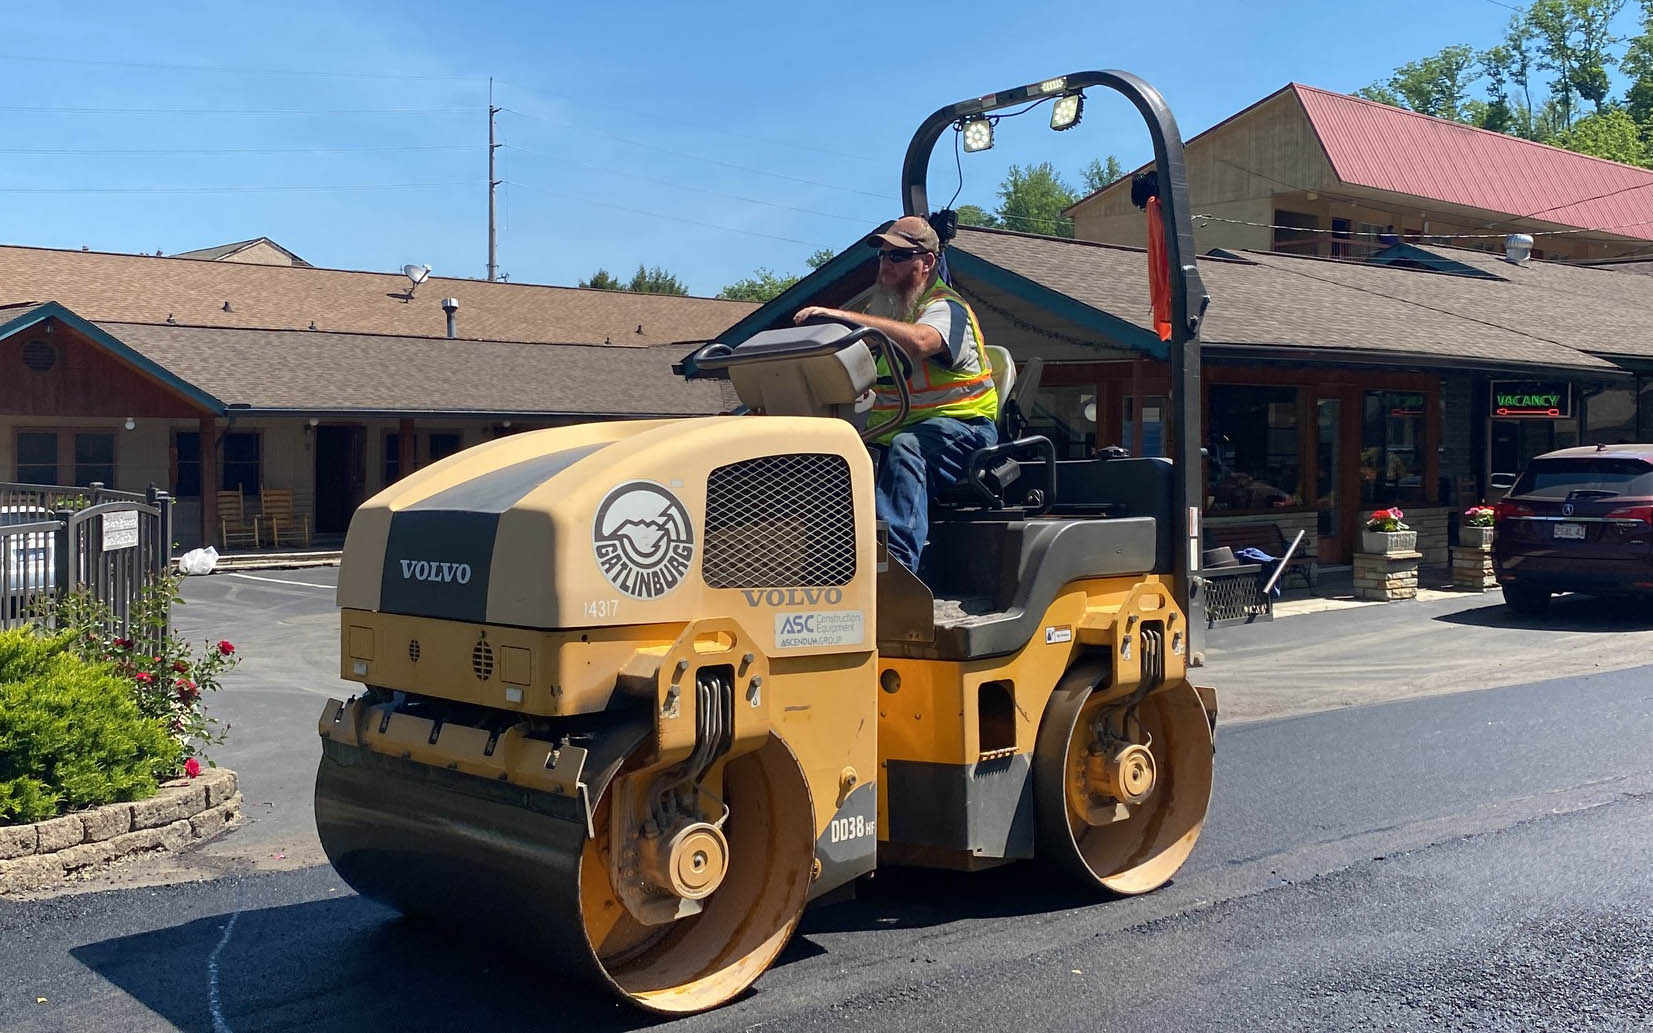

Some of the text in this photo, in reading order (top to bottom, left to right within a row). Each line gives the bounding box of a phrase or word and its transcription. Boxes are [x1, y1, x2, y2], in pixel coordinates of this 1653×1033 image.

[1496, 394, 1560, 407] VACANCY
[400, 559, 471, 585] VOLVO
[595, 543, 693, 598] GATLINBURG
[741, 587, 843, 608] VOLVO
[584, 600, 619, 617] 14317
[781, 614, 814, 634] ASC
[816, 613, 861, 624] Construction
[816, 624, 855, 634] Equipment
[781, 637, 817, 647] ASCENDUM
[865, 821, 875, 836] HF
